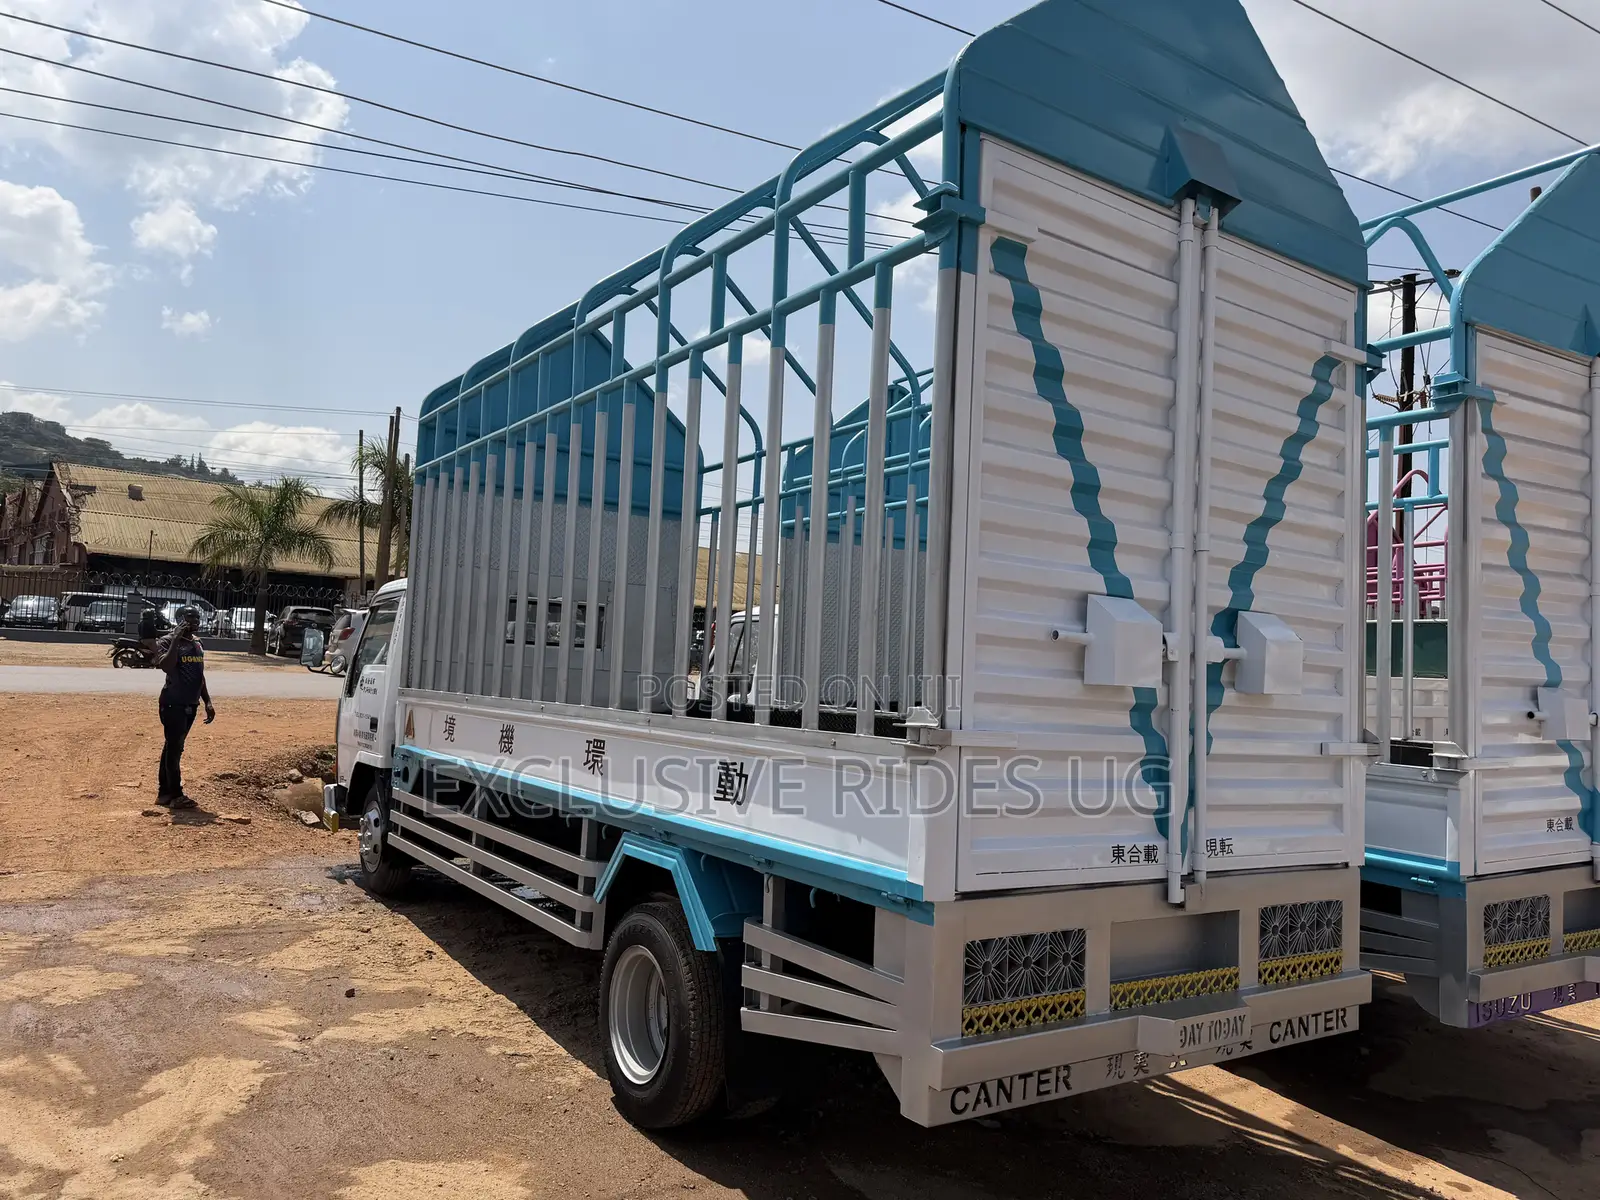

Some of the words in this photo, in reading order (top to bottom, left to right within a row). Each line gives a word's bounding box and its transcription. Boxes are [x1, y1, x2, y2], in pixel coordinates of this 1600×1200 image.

[1110, 844, 1159, 864] 東合載
[1476, 992, 1532, 1023] ISUZU
[1180, 1022, 1204, 1048] DAY
[1269, 1007, 1348, 1044] CANTER
[950, 1064, 1073, 1115] CANTER
